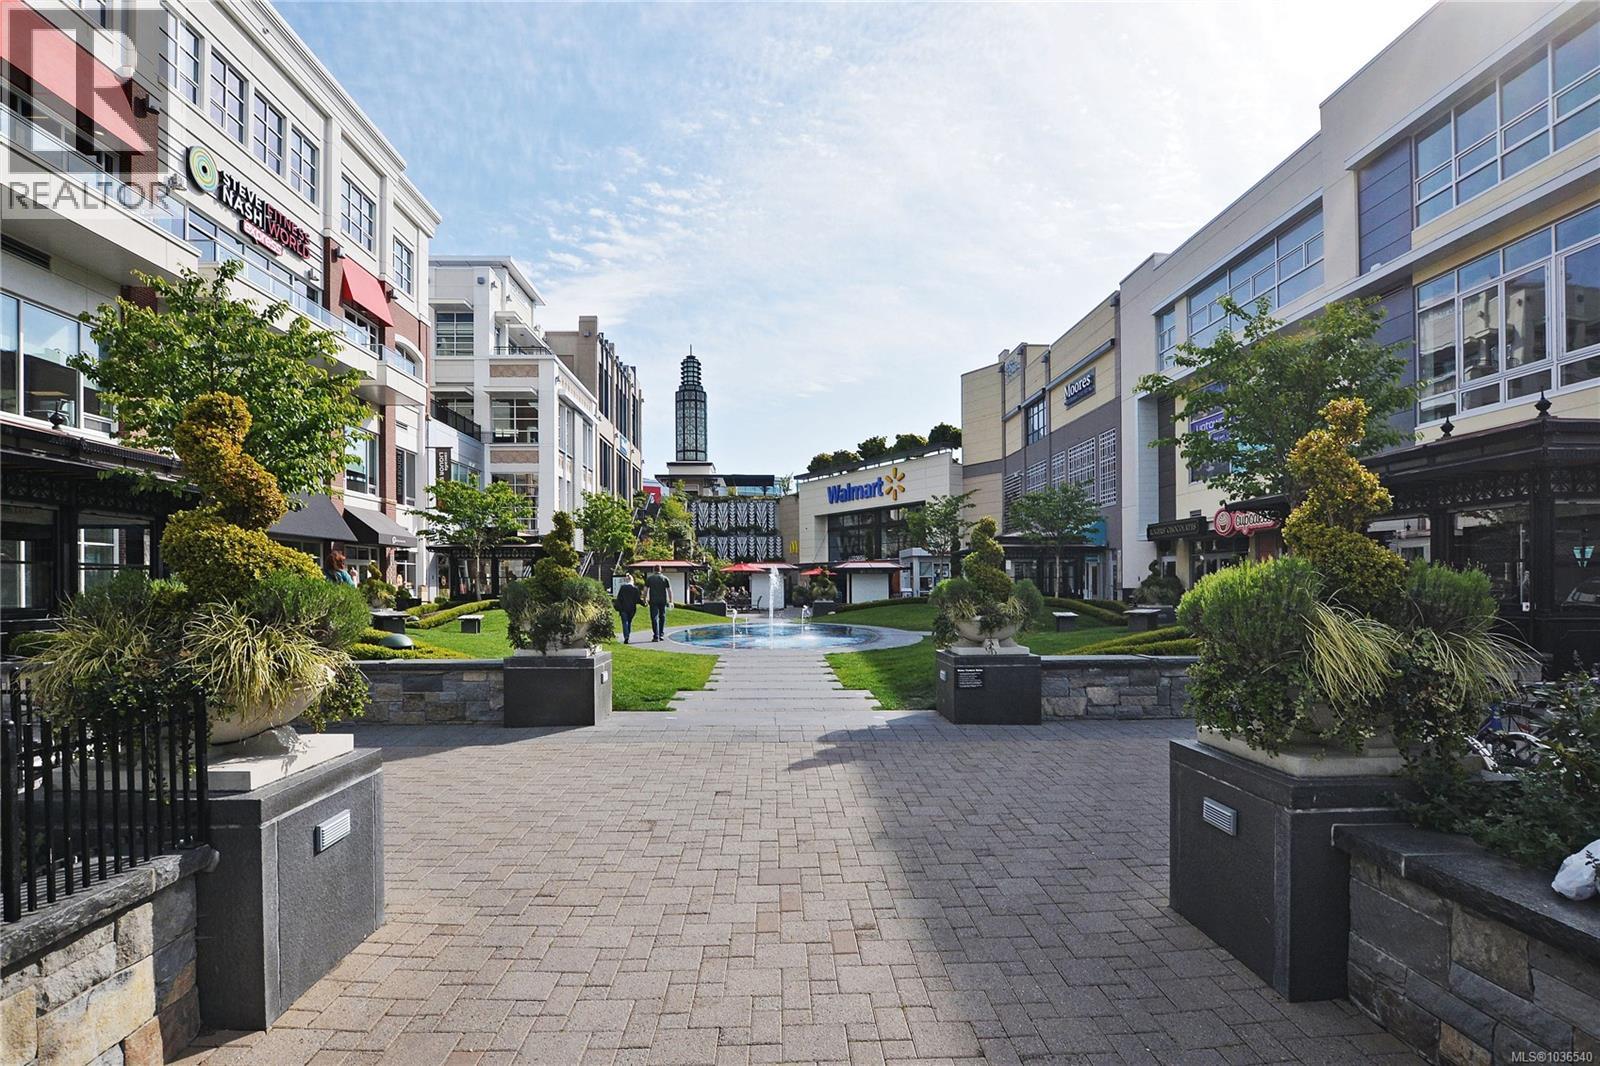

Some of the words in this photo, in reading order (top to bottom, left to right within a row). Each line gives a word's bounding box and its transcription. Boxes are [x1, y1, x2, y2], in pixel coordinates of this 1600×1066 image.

[222, 172, 264, 212] STEVE
[222, 185, 264, 228] NASH
[266, 203, 311, 246] FITNESS
[267, 219, 311, 259] WORLD
[1064, 374, 1091, 400] Moores
[827, 477, 884, 504] Walmart
